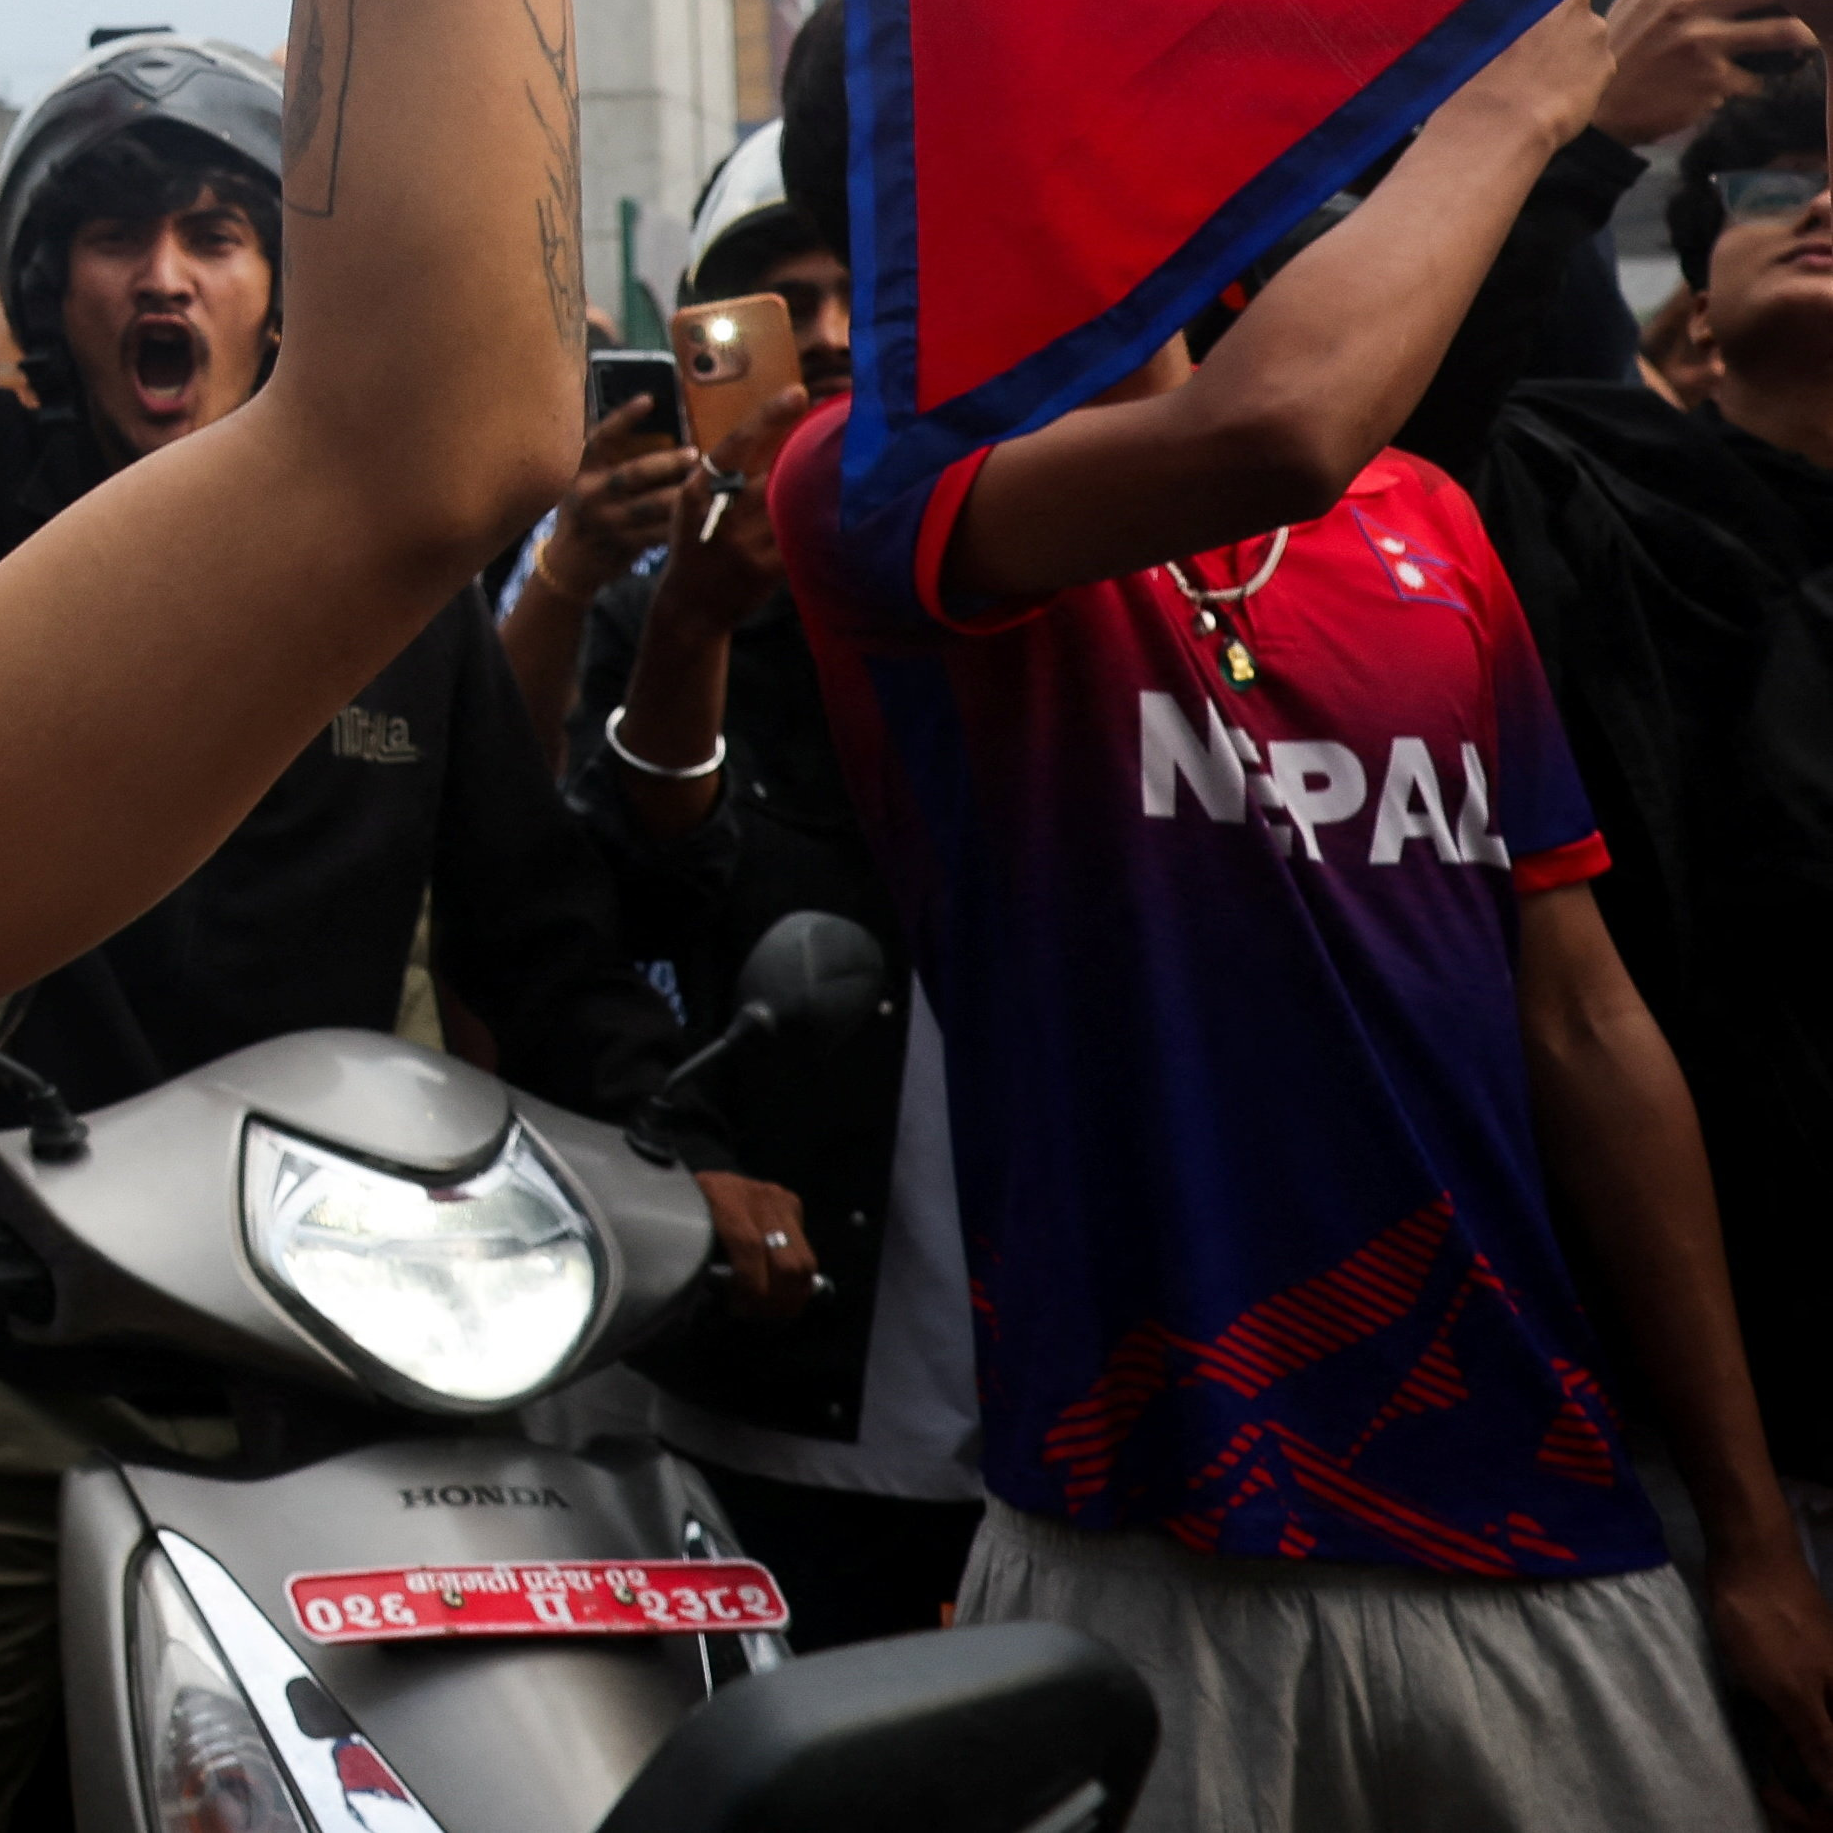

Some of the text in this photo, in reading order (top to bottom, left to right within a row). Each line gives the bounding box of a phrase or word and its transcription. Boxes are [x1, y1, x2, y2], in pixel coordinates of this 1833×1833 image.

[399, 1485, 571, 1509] HONDA
[305, 1584, 777, 1633] ०२६ प २३८२
